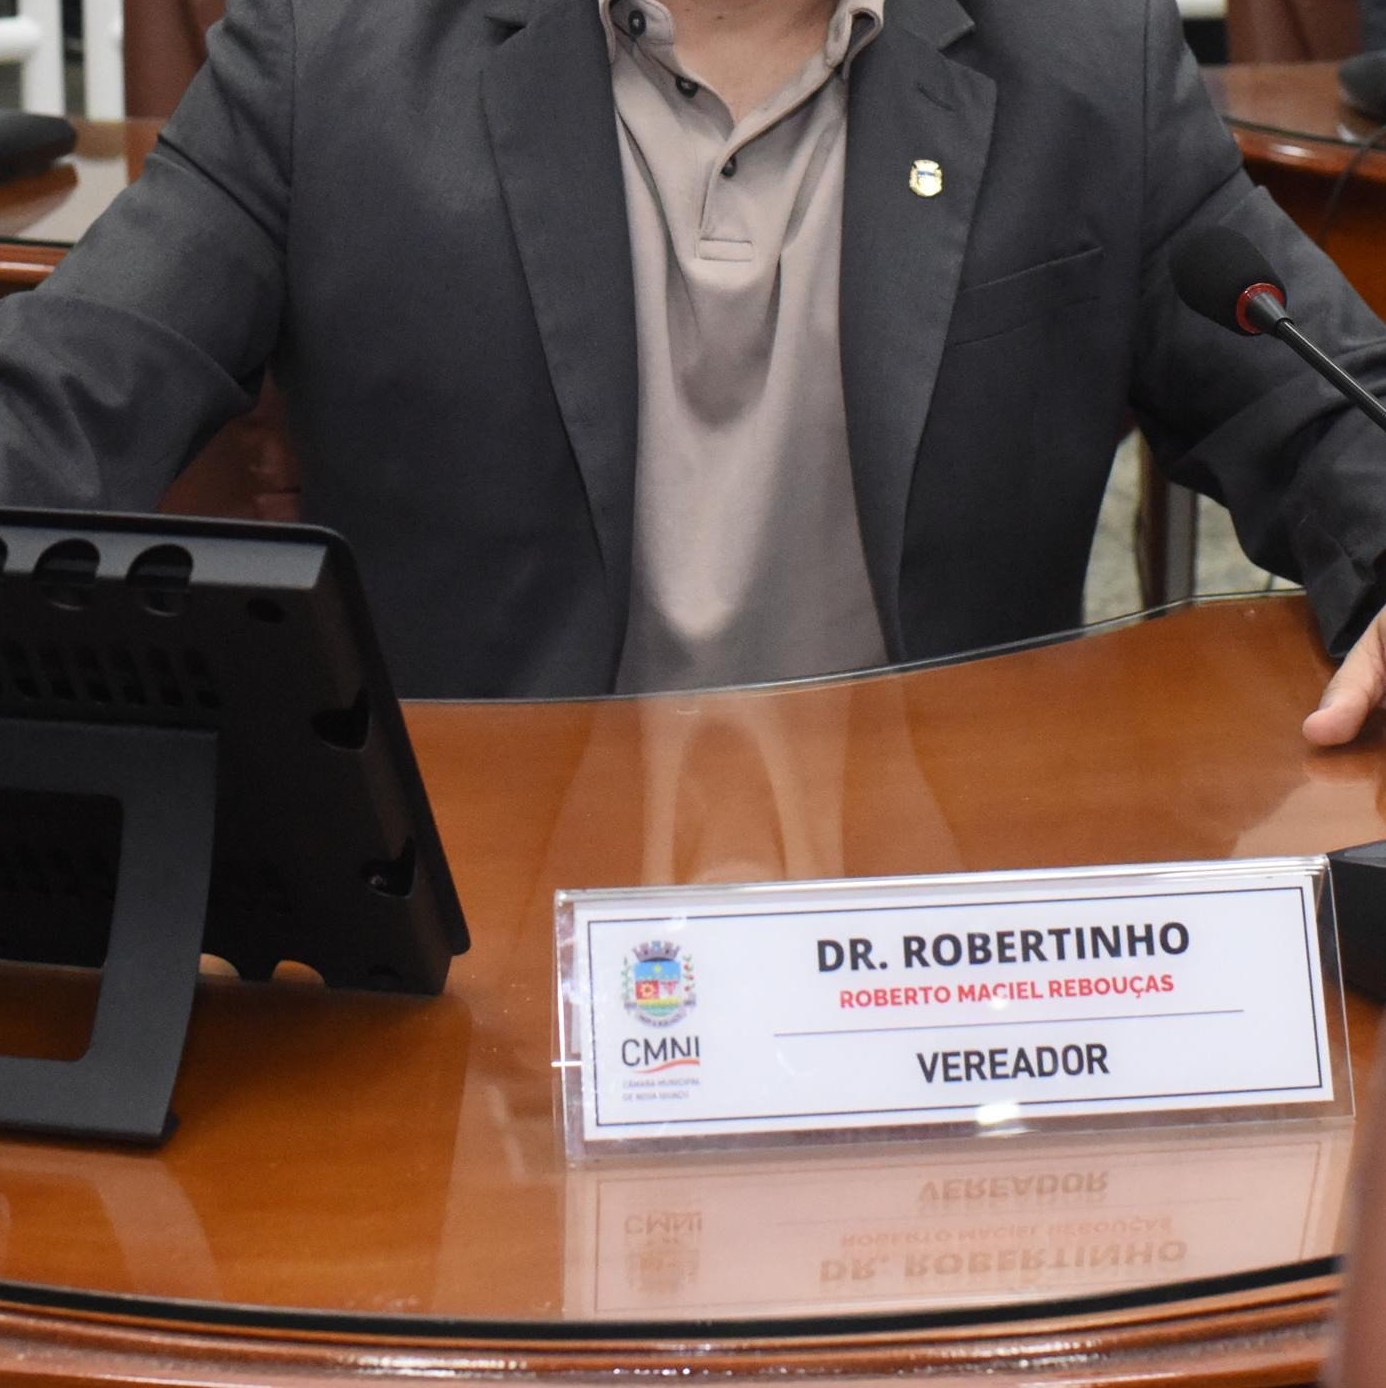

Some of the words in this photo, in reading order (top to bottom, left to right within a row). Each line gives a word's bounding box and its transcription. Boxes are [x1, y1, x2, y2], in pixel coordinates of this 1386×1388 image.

[817, 937, 888, 972] DR.
[902, 922, 1190, 968] ROBERTINHO
[839, 986, 951, 1009] ROBERTO
[958, 981, 1043, 1003] MACIEL
[1048, 974, 1175, 1002] REBOUÇAS
[621, 1036, 700, 1067] CMNI
[916, 1043, 1110, 1084] VEREADOR
